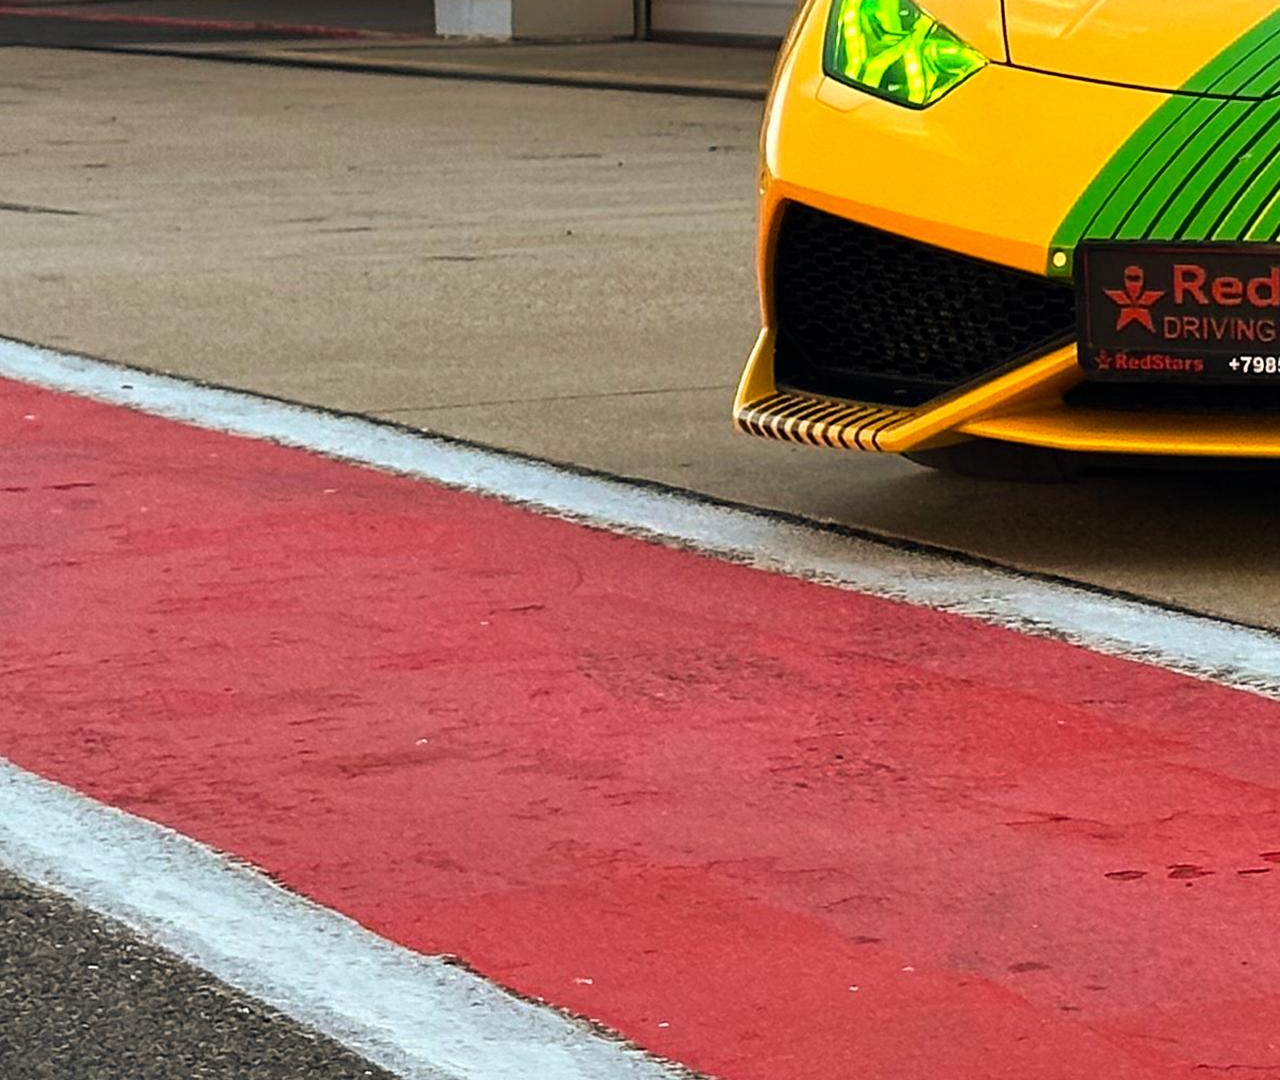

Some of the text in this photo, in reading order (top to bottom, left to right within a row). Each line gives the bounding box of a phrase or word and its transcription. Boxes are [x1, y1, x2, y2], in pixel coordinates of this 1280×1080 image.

[1172, 263, 1280, 309] Red
[1163, 316, 1277, 342] DRIVING
[1115, 354, 1204, 372] RedStars
